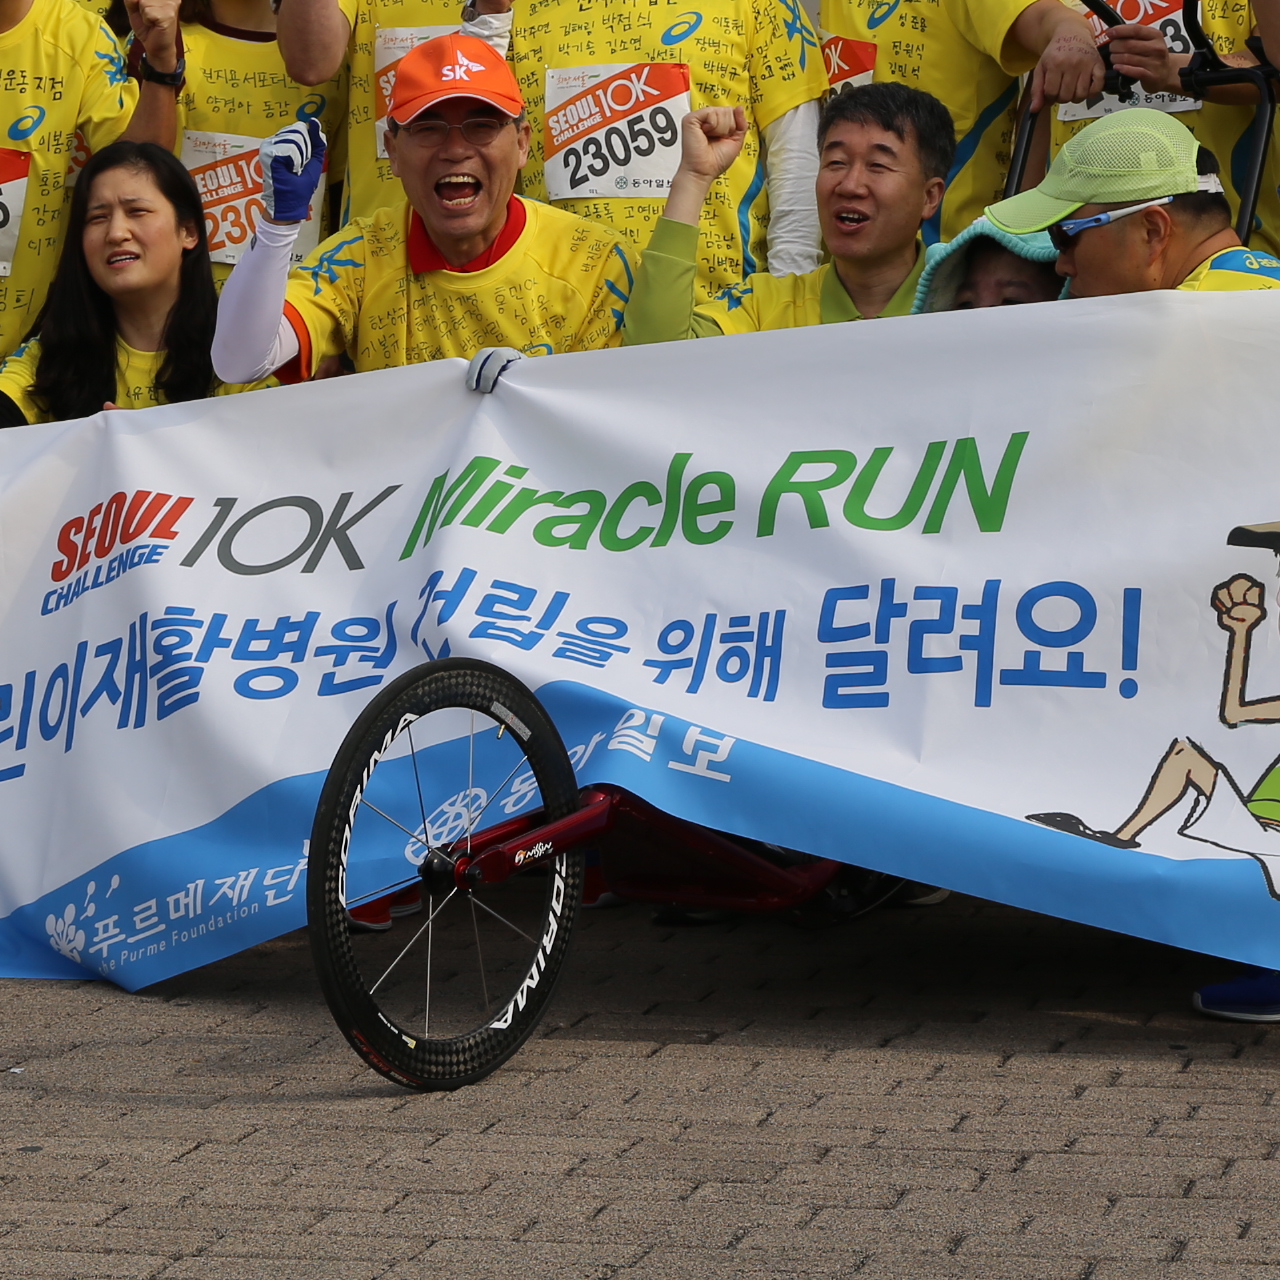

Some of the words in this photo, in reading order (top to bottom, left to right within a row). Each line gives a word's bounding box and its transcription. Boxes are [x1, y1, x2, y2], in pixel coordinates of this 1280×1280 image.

[441, 65, 471, 81] SK
[548, 94, 600, 136] SEOUL
[595, 65, 661, 117] 10K
[553, 113, 603, 146] CHALLENGE
[563, 106, 678, 190] 23059
[194, 162, 242, 191] EOUL
[201, 183, 245, 203] ALLENGE
[206, 197, 267, 253] 230
[51, 489, 195, 582] SEOUL
[179, 483, 403, 576] 10K
[398, 453, 735, 561] Miracle
[756, 431, 1030, 538] RUN
[40, 543, 170, 616] CHALLENGE
[643, 609, 786, 702] 위해
[819, 577, 1143, 710] 달려요!
[338, 712, 420, 909] CORIMA
[88, 858, 309, 958] 푸르메재단
[120, 940, 167, 967] Purme
[171, 902, 259, 947] Foundation
